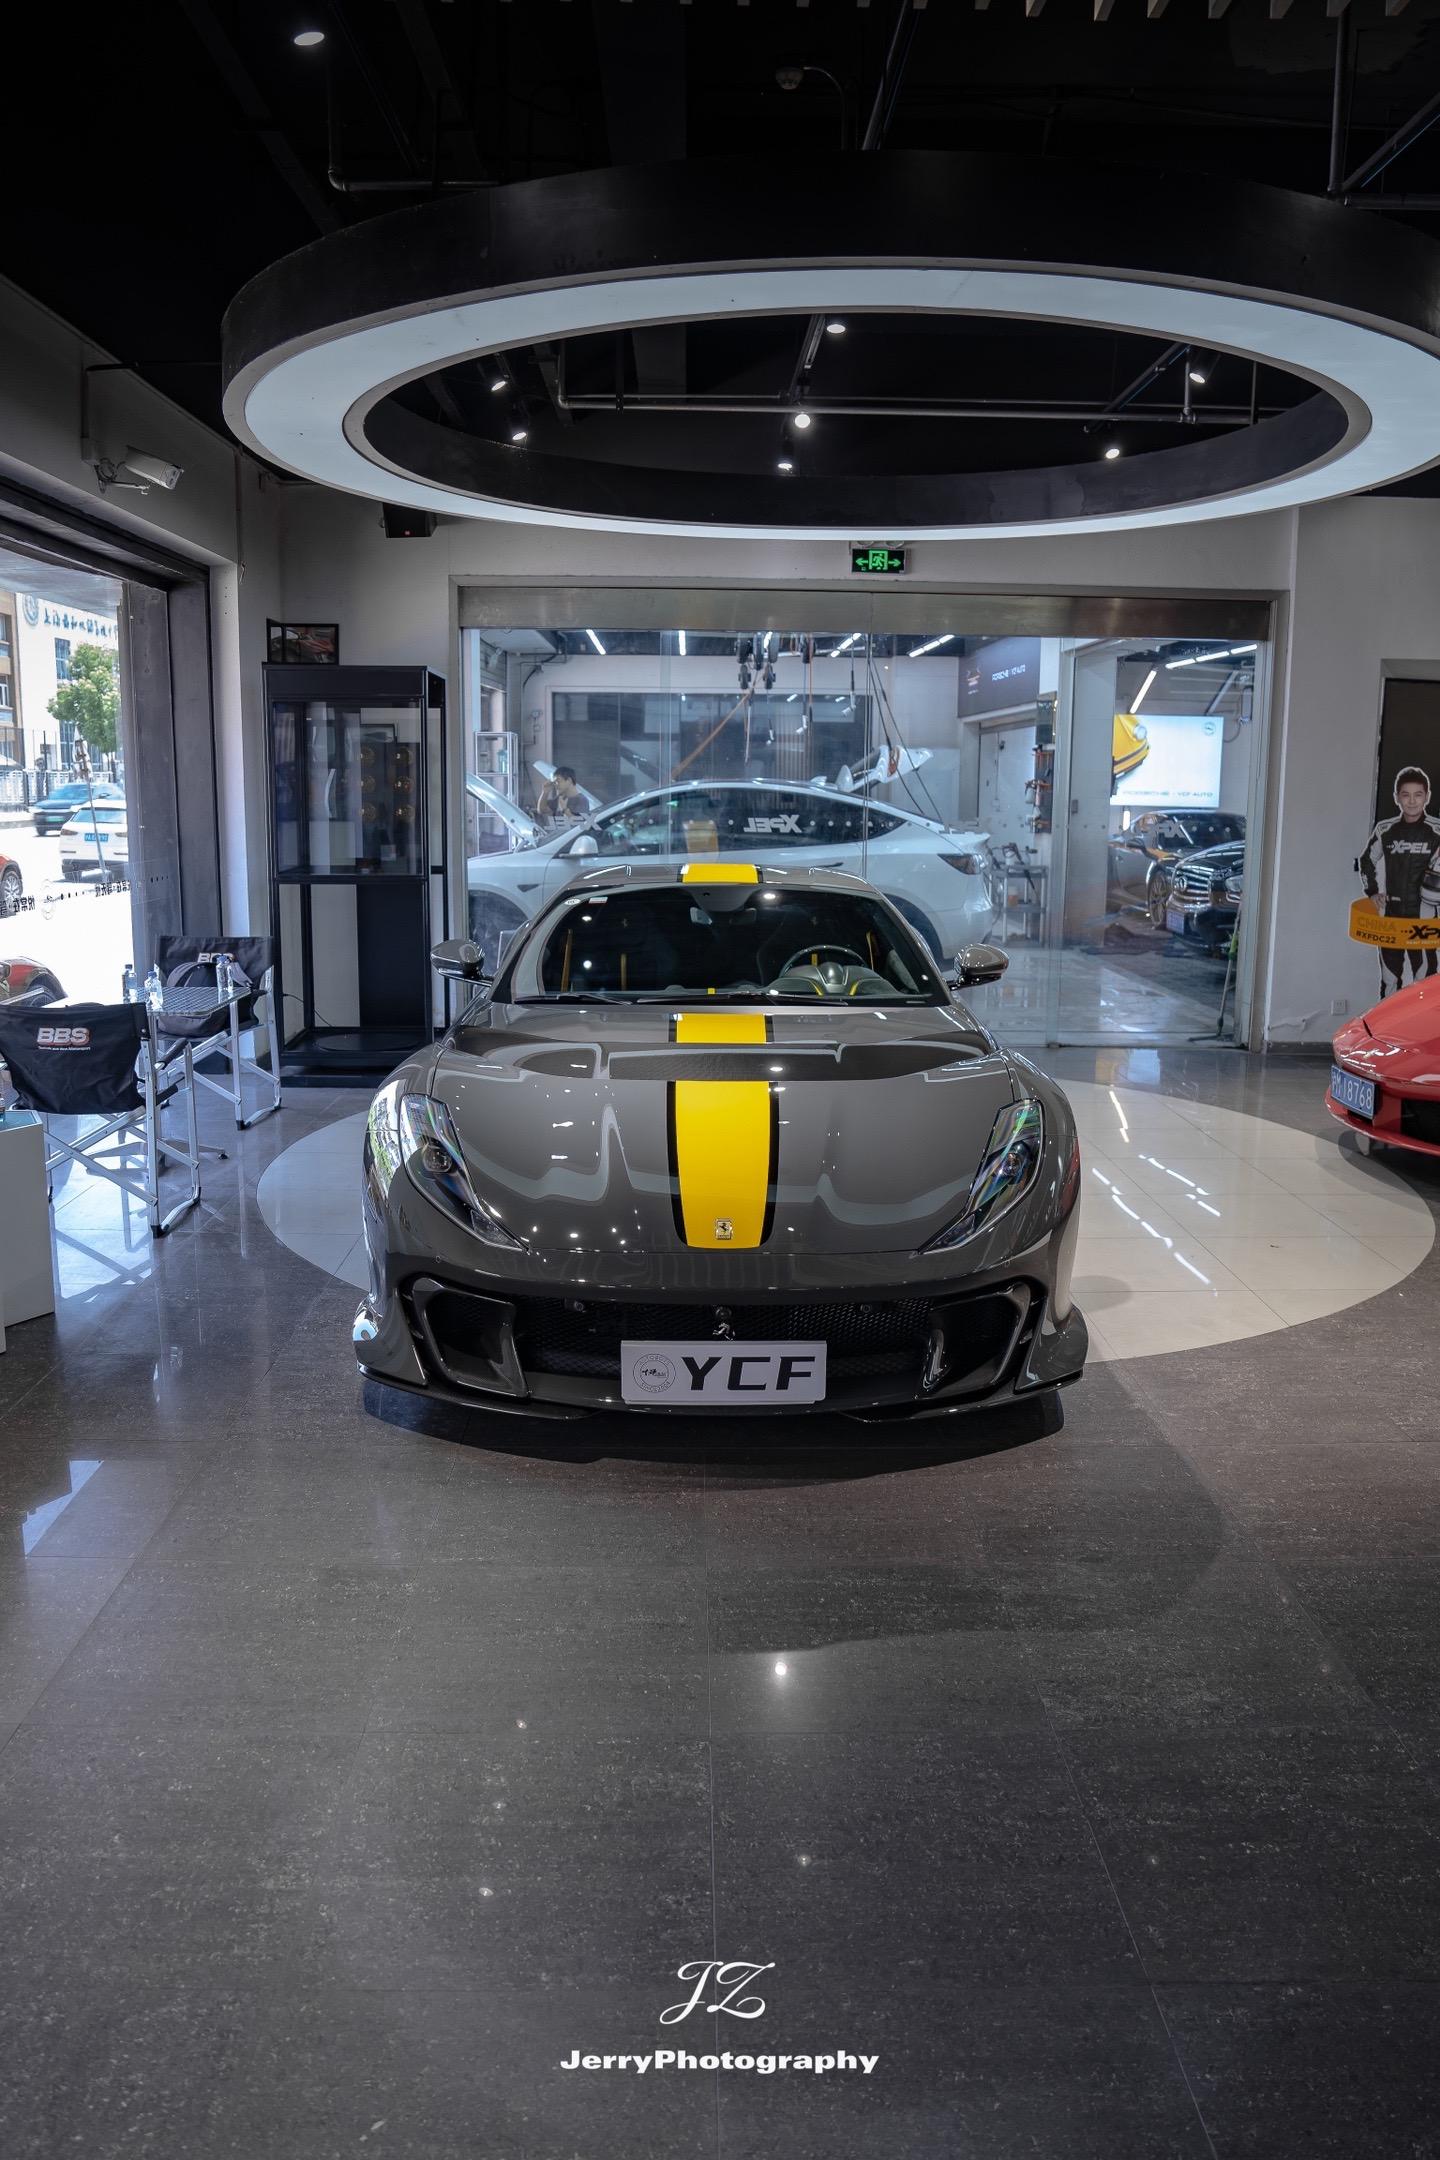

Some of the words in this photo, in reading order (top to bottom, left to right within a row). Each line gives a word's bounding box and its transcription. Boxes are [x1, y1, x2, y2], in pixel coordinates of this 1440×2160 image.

[1389, 840, 1432, 854] XPEL
[1408, 925, 1440, 940] XP
[37, 1027, 90, 1045] BBS
[681, 1356, 816, 1391] YCF
